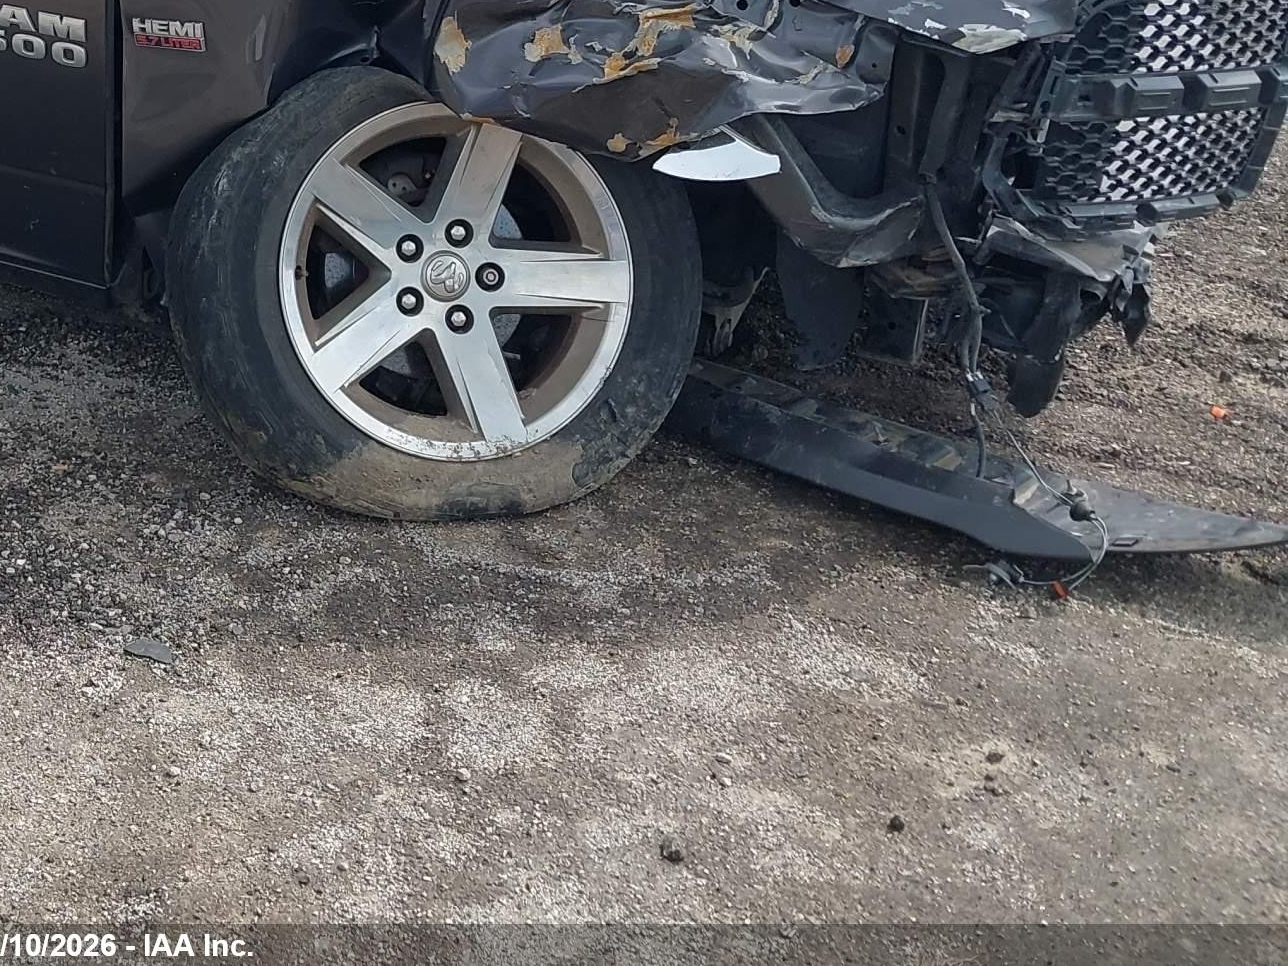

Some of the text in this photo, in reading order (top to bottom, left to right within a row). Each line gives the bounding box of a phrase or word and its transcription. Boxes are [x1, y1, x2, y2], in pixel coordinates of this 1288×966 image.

[132, 17, 204, 39] HEMI
[136, 35, 201, 50] 5.7 LITER
